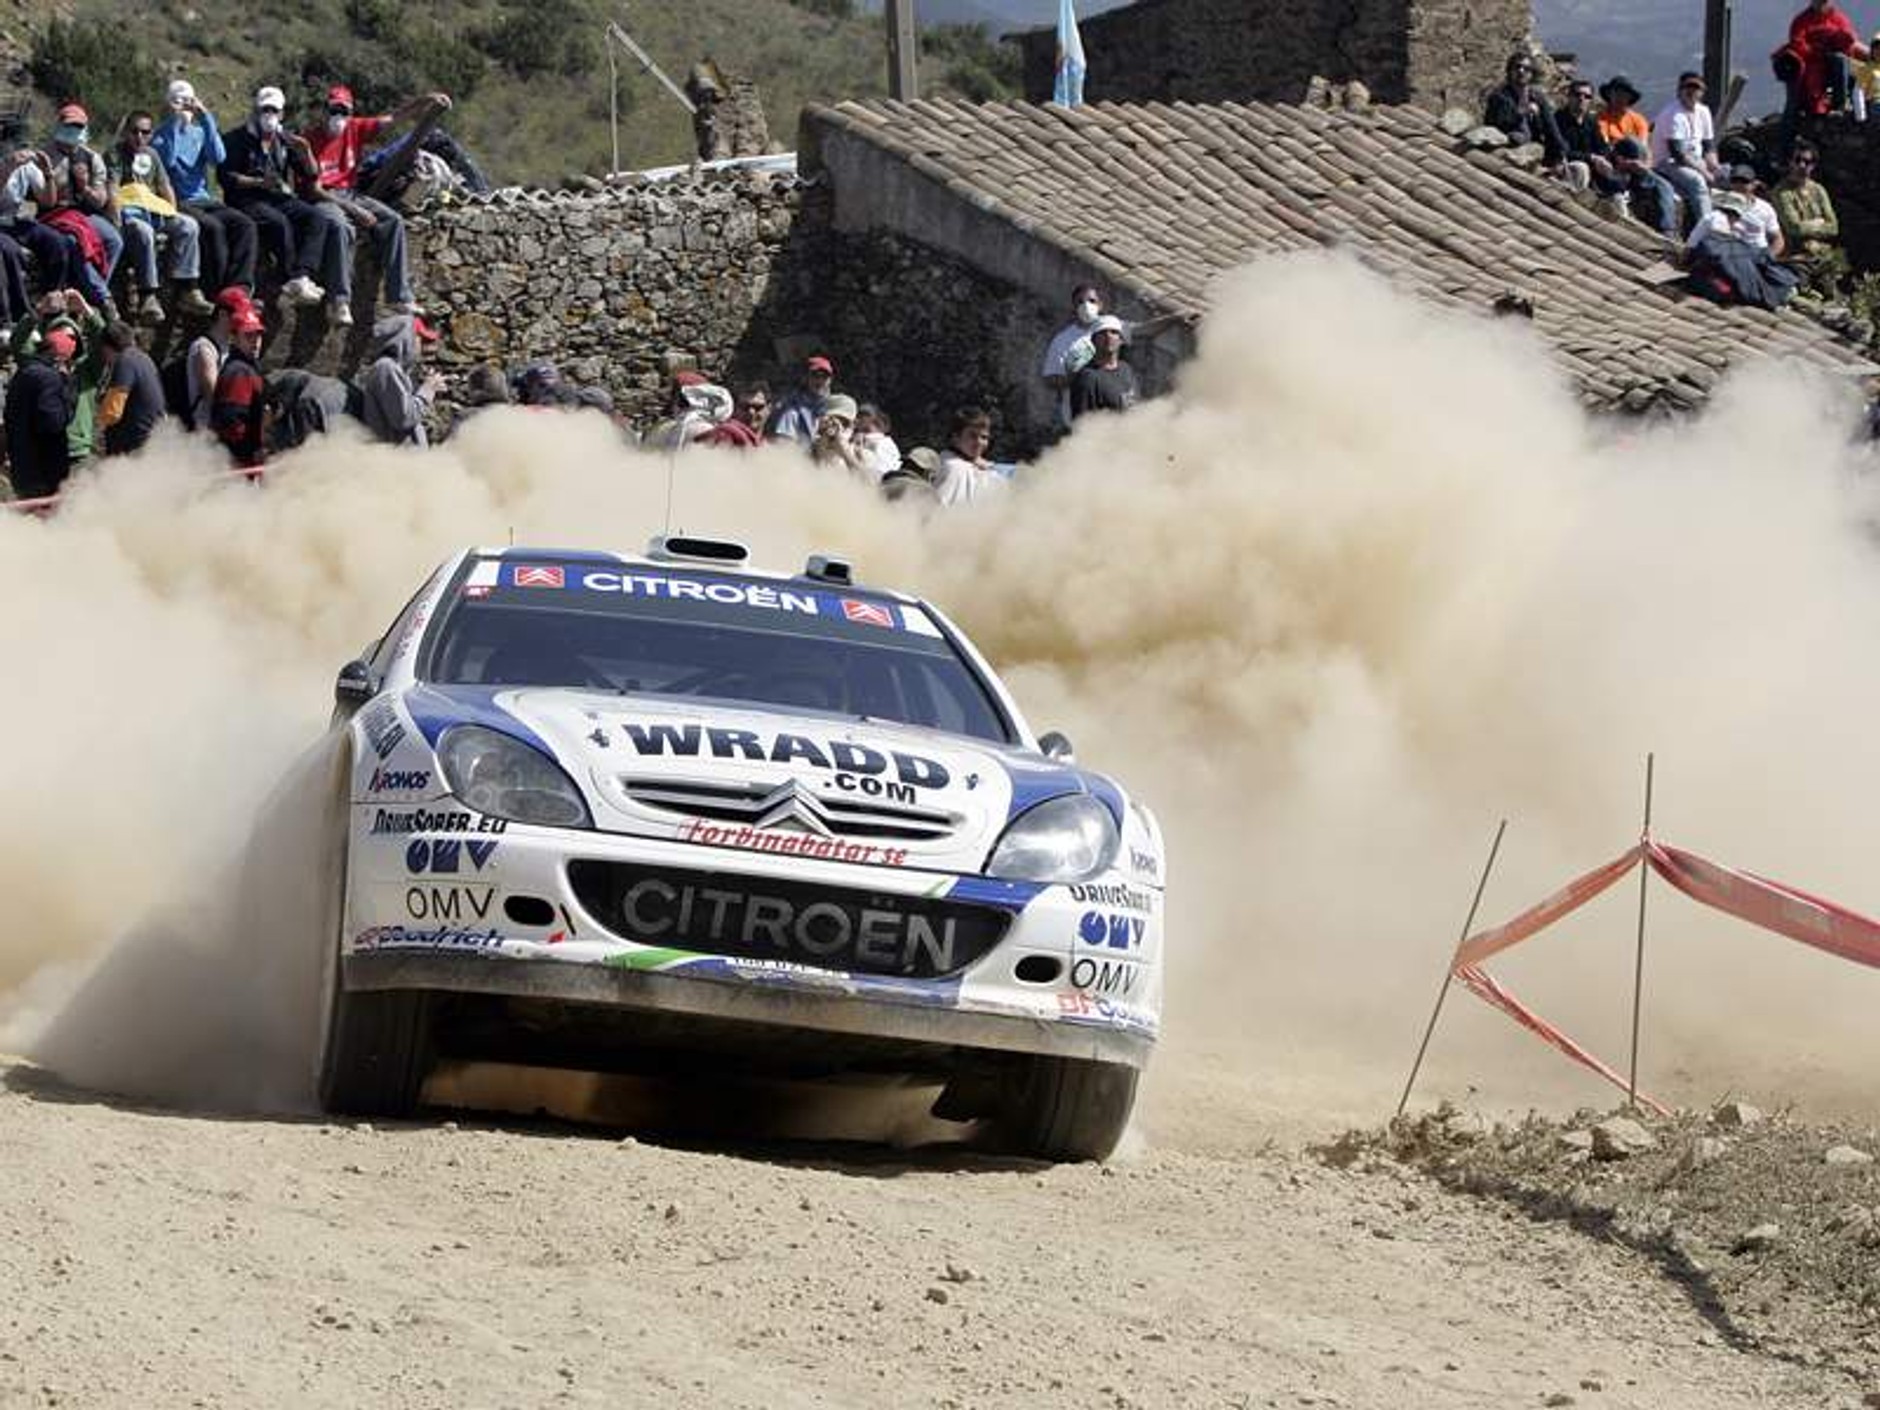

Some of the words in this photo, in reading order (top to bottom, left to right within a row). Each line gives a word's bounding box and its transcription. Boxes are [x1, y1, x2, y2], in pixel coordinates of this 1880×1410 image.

[583, 572, 819, 615] CITROËN
[622, 723, 951, 789] WRADD
[406, 839, 498, 873] OMV
[406, 887, 495, 920] OMV
[622, 878, 956, 972] CITROËN
[1078, 911, 1146, 950] OMV
[1071, 958, 1139, 995] OMV
